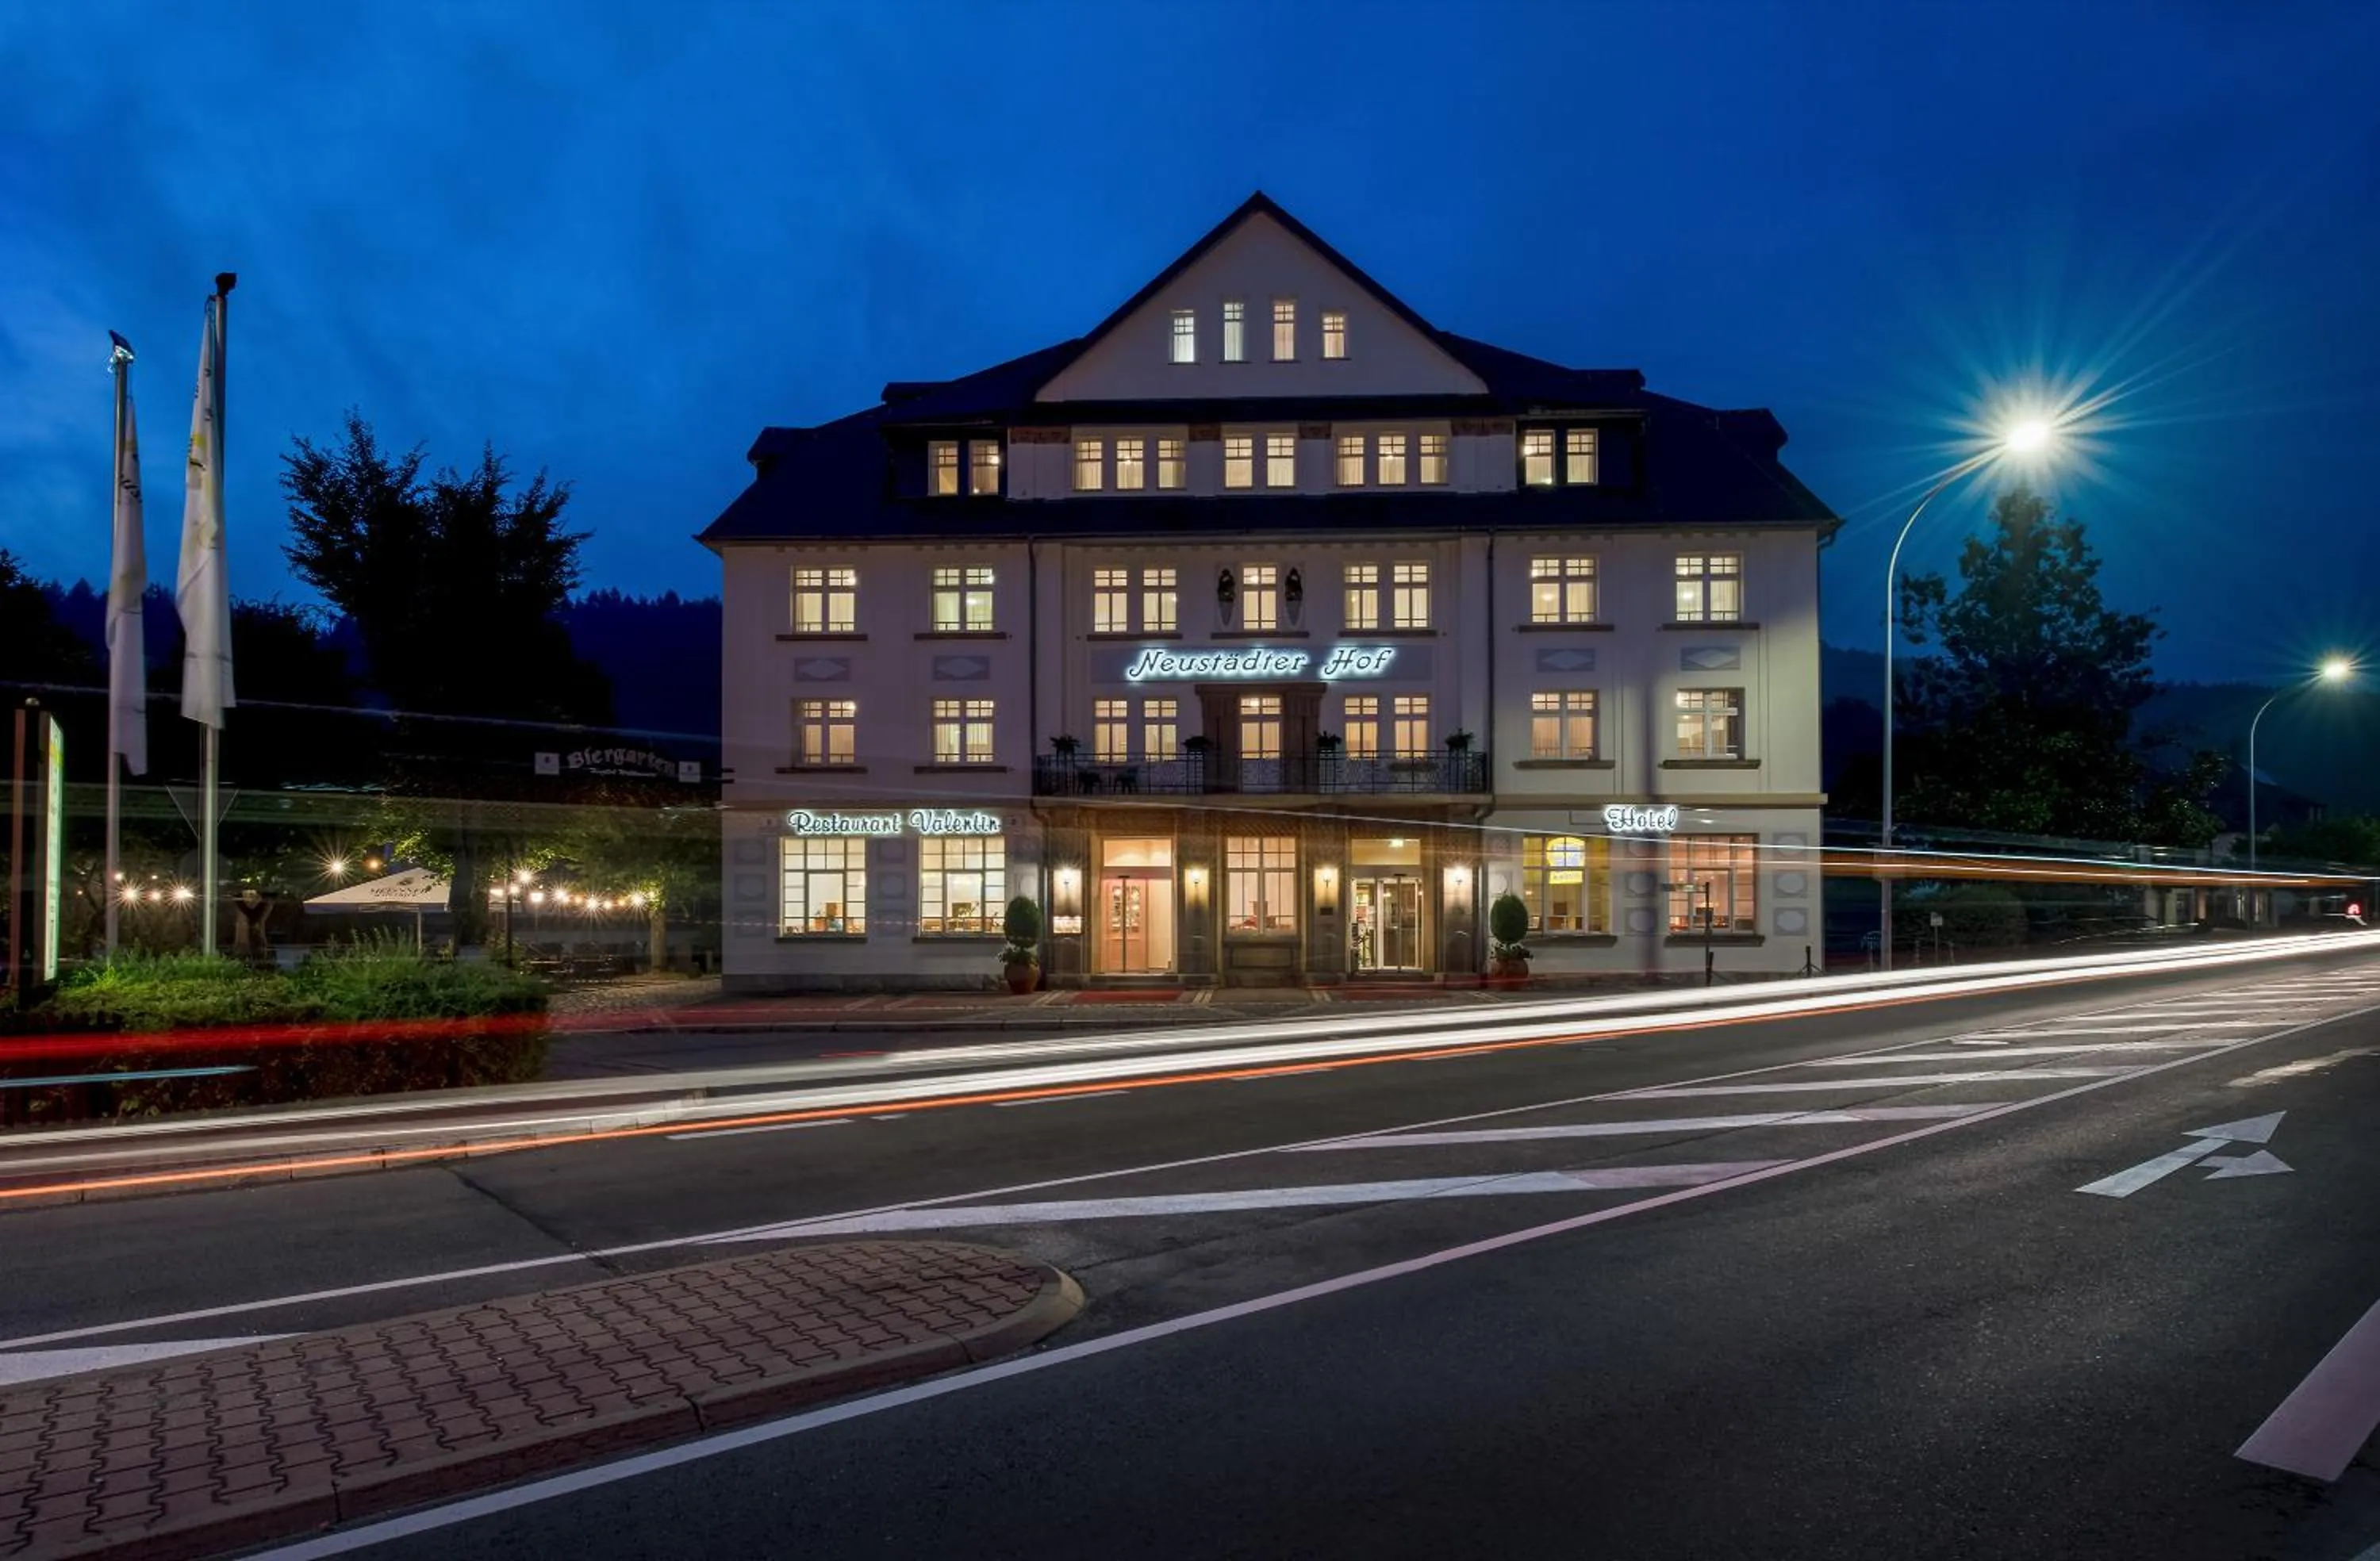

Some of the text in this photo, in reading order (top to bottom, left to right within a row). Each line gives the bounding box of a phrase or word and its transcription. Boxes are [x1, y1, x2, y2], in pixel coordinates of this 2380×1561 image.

[1128, 648, 1393, 678] Neustädter Hof
[567, 746, 676, 774] Biergarten
[788, 810, 1002, 833] Restaurant Valentin
[1606, 807, 1677, 829] Hotel
